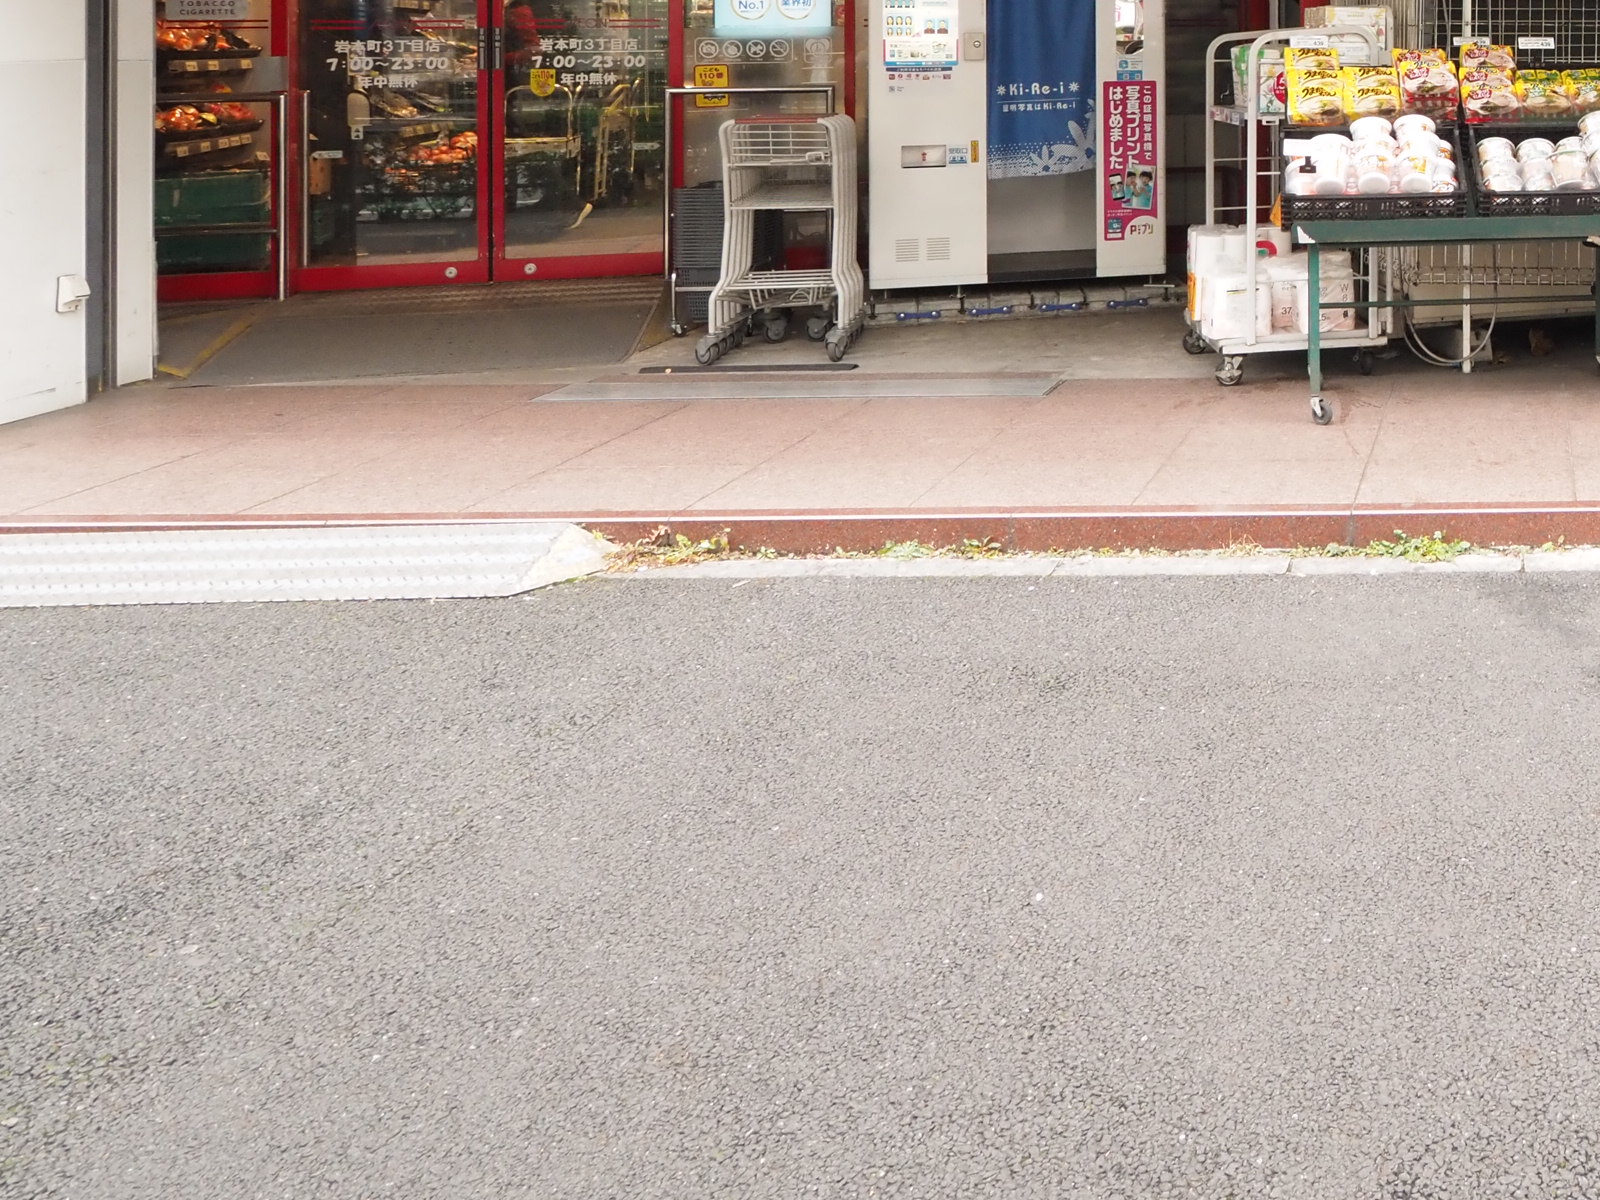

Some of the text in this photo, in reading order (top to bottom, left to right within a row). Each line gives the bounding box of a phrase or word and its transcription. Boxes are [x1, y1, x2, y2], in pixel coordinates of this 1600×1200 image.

[738, 0, 764, 10] No.1
[539, 38, 638, 51] 岩本町3丁目店
[358, 76, 419, 89] 年中無休
[560, 72, 618, 85] 年中無休
[1009, 82, 1064, 95] Ki-Re-i
[1109, 86, 1123, 169] はじめました
[1126, 86, 1140, 168] 写真プリント
[1143, 85, 1152, 160] この証明写真機で
